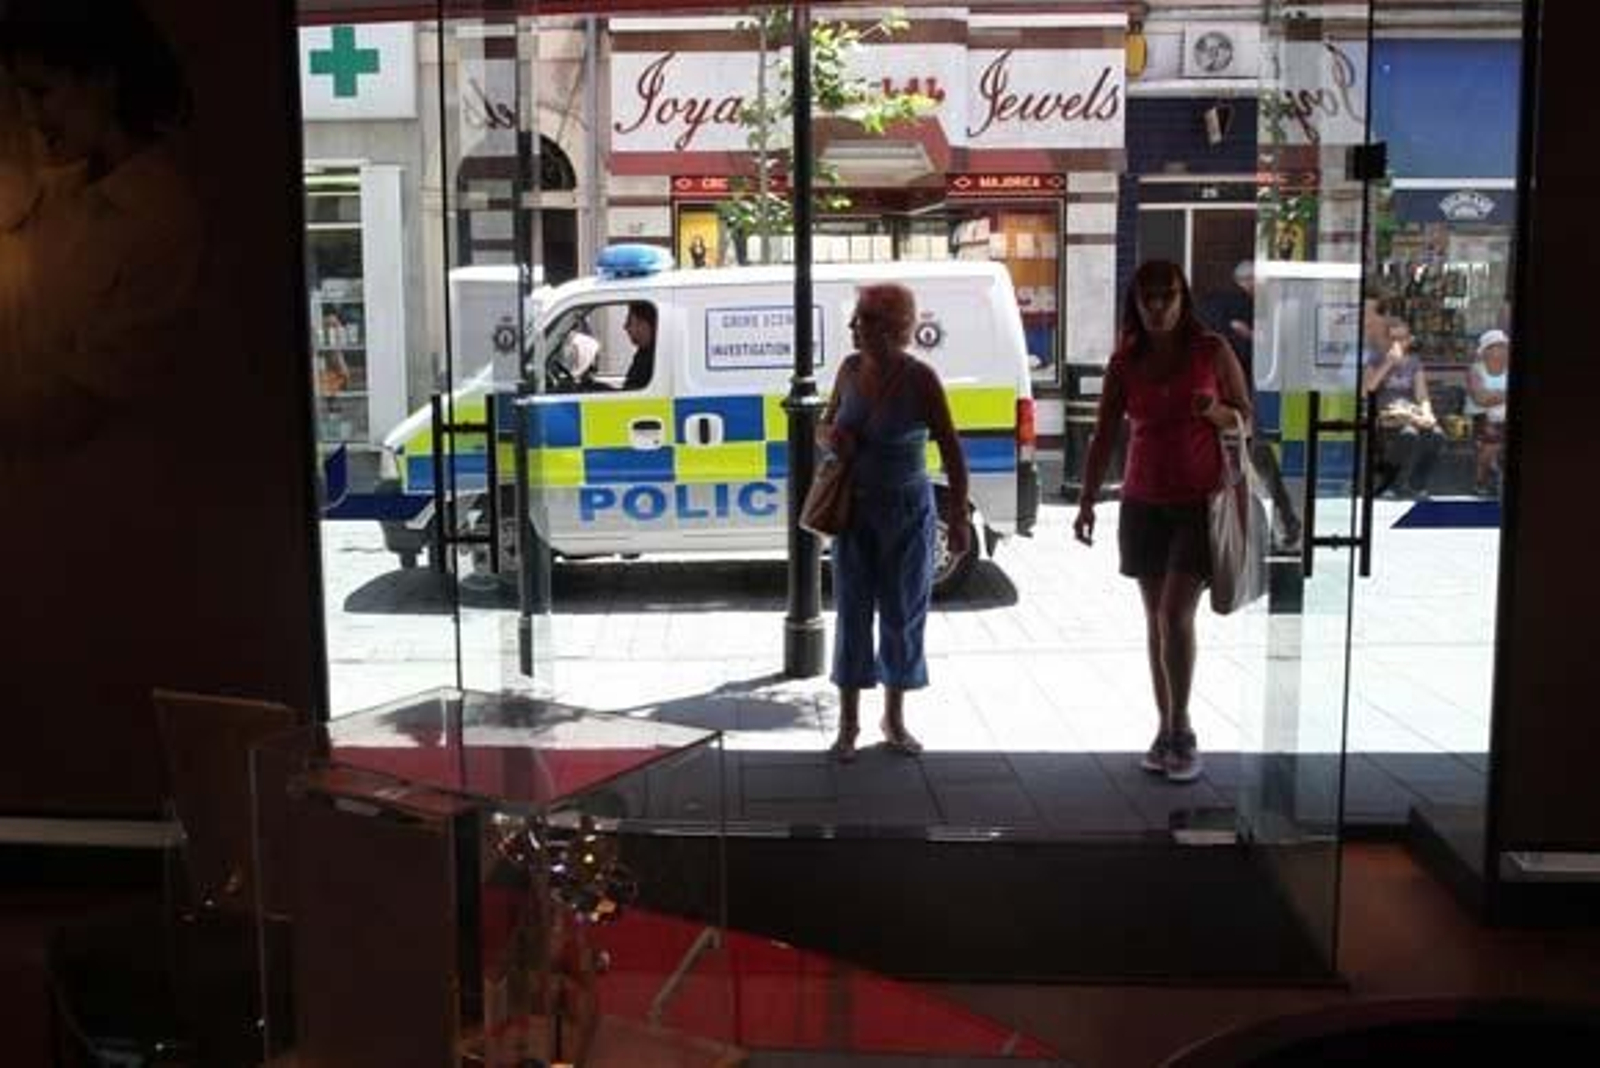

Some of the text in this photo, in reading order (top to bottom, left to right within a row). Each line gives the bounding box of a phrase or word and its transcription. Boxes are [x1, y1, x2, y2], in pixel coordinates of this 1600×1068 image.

[966, 48, 1120, 138] Jewels
[711, 341, 792, 357] INVESTIGATION
[579, 482, 779, 521] POLIC
